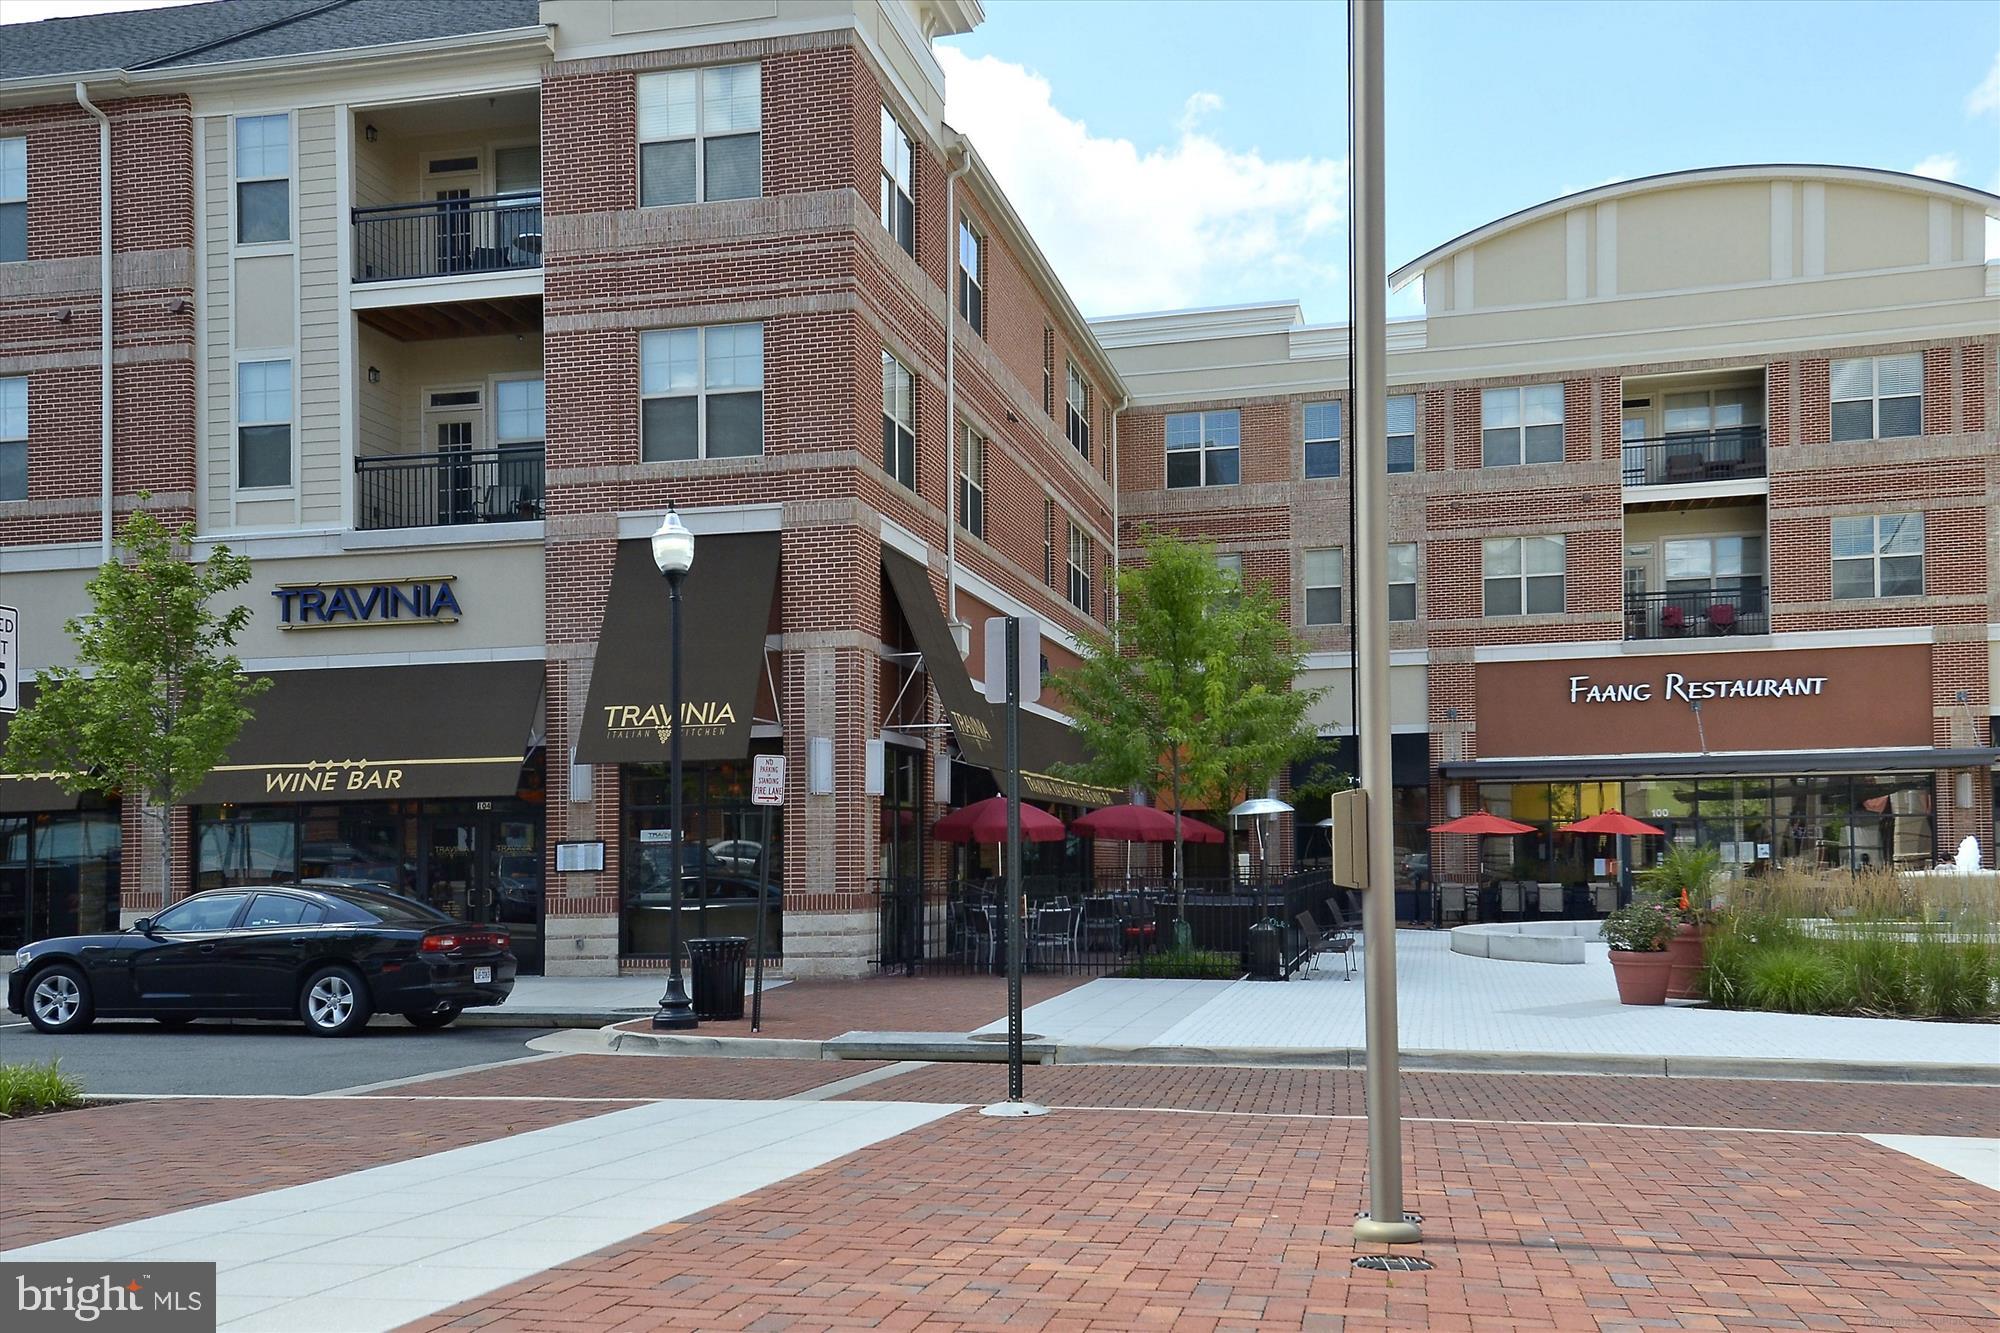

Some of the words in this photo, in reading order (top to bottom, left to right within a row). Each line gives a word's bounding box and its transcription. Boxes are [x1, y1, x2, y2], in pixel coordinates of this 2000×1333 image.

[271, 582, 463, 622] TRAVINIA
[604, 702, 736, 727] TRAVINIA
[606, 730, 651, 739] ITALIAN
[681, 727, 726, 737] ITCHEN
[266, 772, 339, 792] WINE
[347, 769, 403, 790] BAR
[758, 777, 779, 785] STANDING
[754, 786, 767, 795] FIRE
[768, 786, 783, 796] LANE
[1651, 809, 1669, 817] 100
